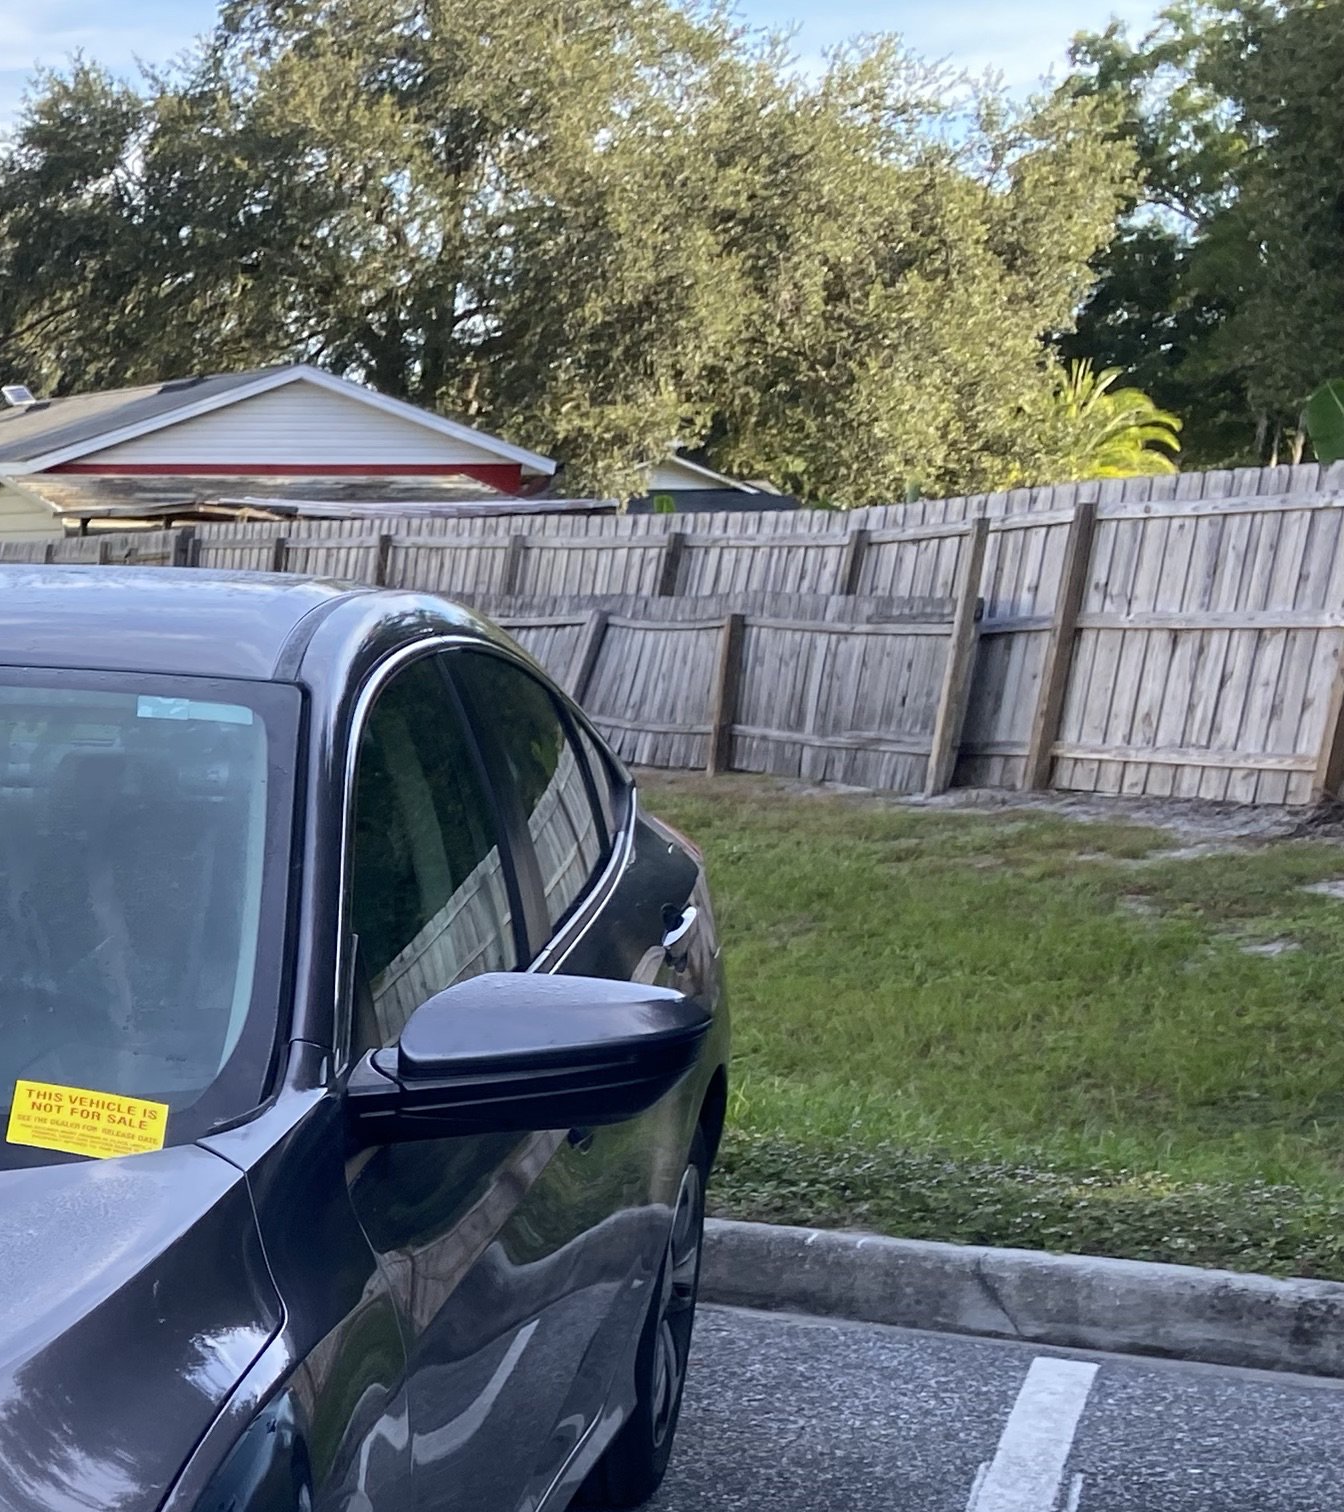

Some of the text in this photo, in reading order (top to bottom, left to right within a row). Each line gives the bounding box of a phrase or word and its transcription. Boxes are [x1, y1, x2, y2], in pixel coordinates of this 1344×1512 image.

[26, 1088, 158, 1120] THIS VEHICLE IS
[31, 1101, 148, 1130] NOT FOR SALE
